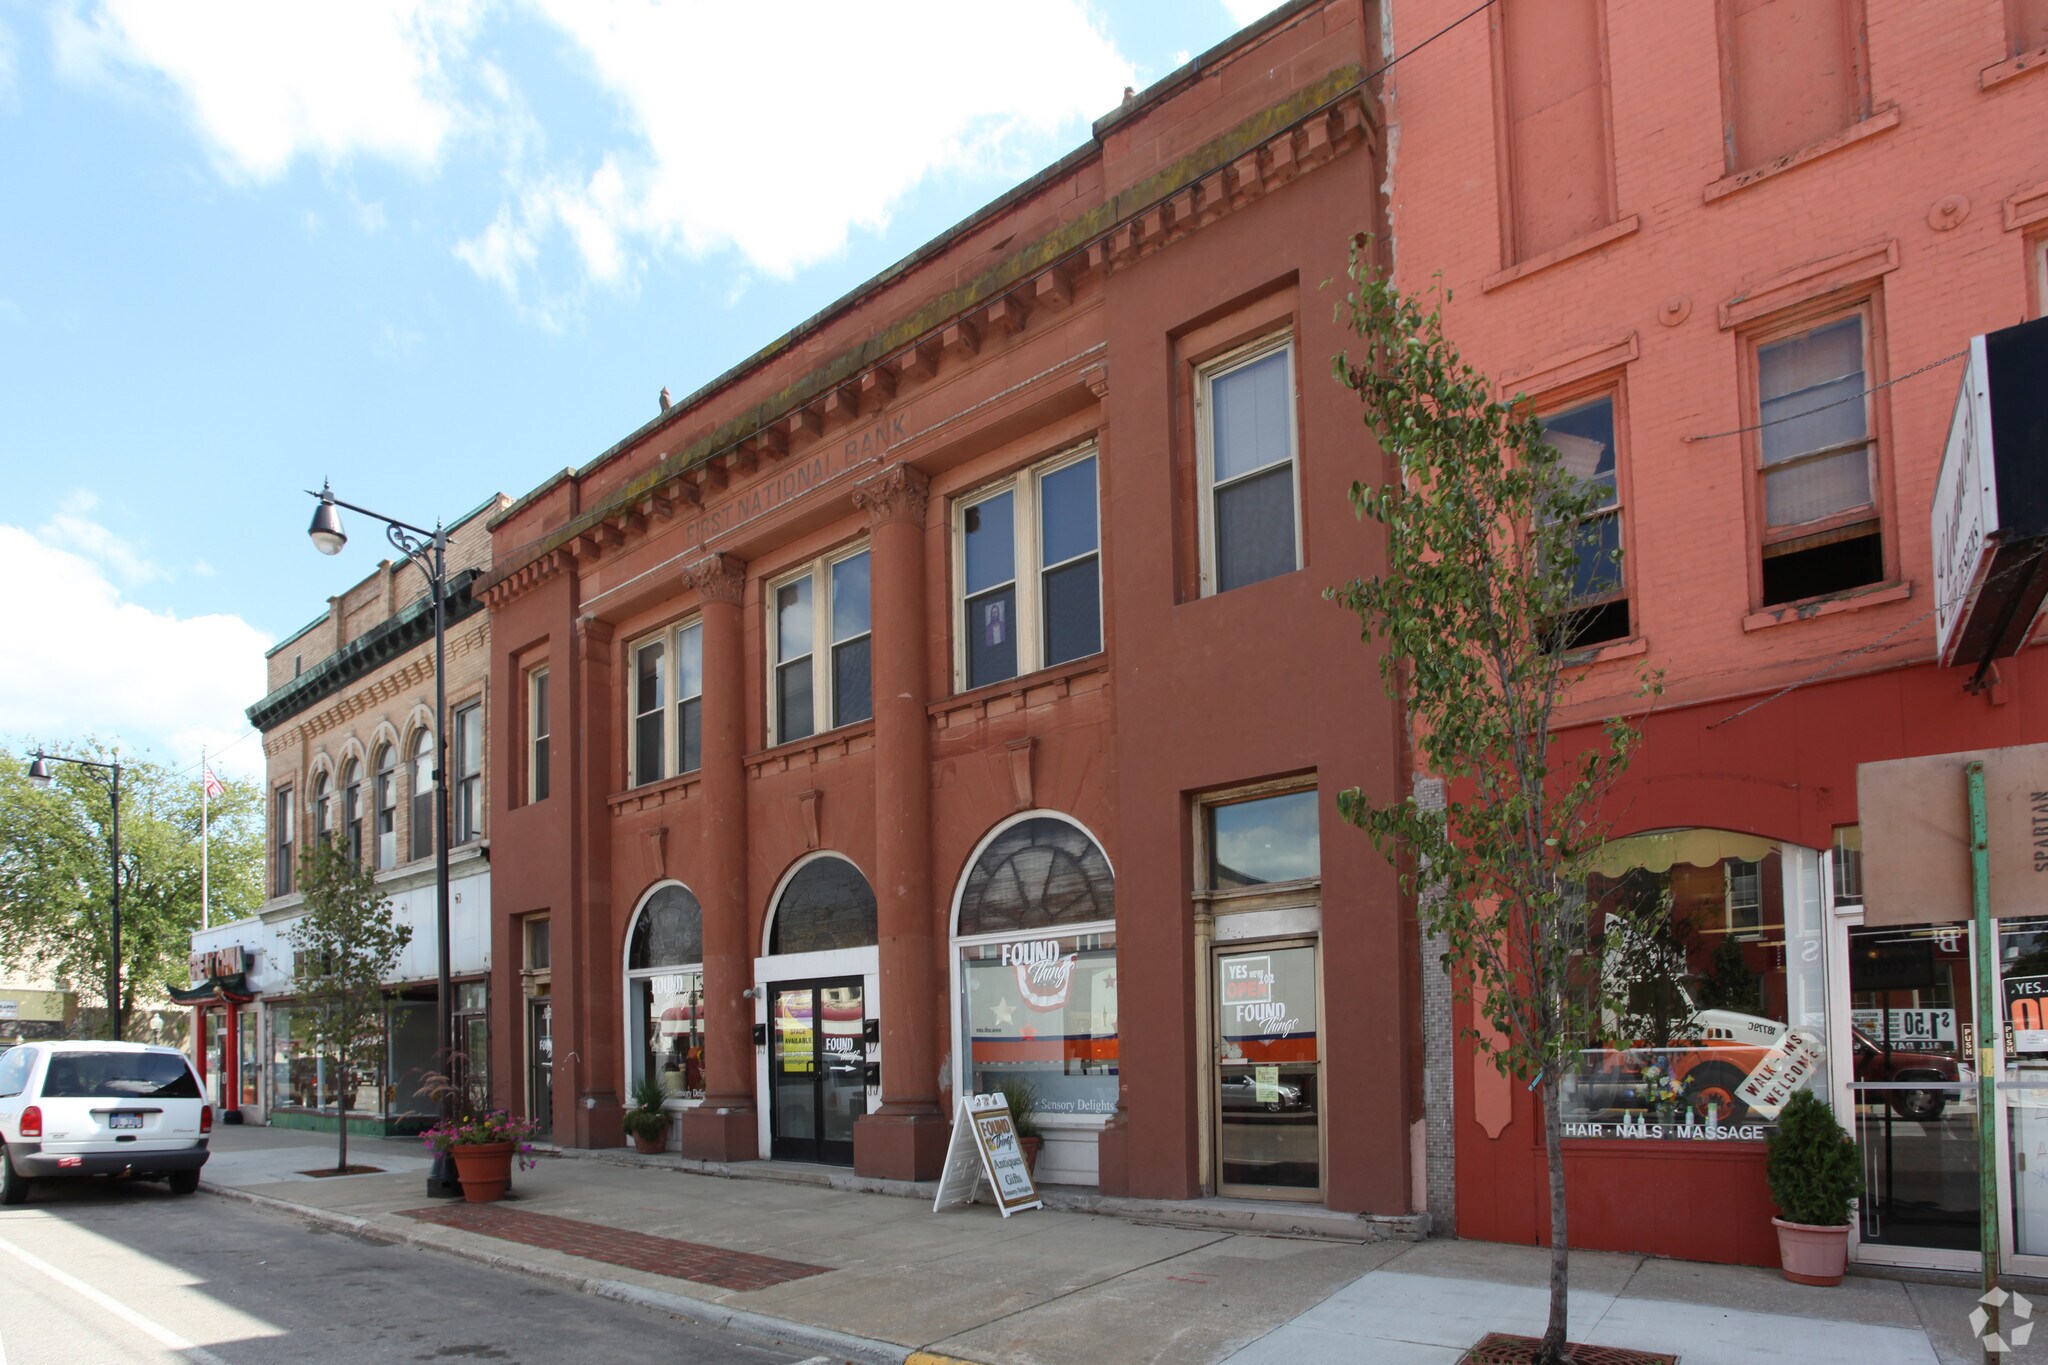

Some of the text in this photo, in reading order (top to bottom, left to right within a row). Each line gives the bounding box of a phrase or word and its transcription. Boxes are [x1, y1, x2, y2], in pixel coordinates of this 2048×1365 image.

[685, 414, 908, 546] FIRST NATIONAL BANK
[1001, 940, 1060, 966] FOUND
[1027, 959, 1075, 989] Things
[1228, 964, 1248, 979] YES
[1258, 973, 1275, 985] 202
[651, 974, 683, 994] FOUND
[1227, 979, 1268, 999] OPEN
[1236, 1002, 1286, 1022] FOUND
[1258, 1016, 1300, 1038] Things
[785, 1037, 812, 1045] AVAILABLE
[826, 1037, 853, 1051] FOUND
[1964, 1028, 1972, 1055] PUSH
[2004, 1025, 2014, 1053] PUSH
[1041, 1098, 1115, 1113] Sensory Delights
[980, 1118, 1010, 1137] FOUND
[1565, 1123, 1764, 1140] HAIR NAILS MASSAGE
[994, 1157, 1023, 1169] Antiques
[1005, 1173, 1022, 1185] Gifts
